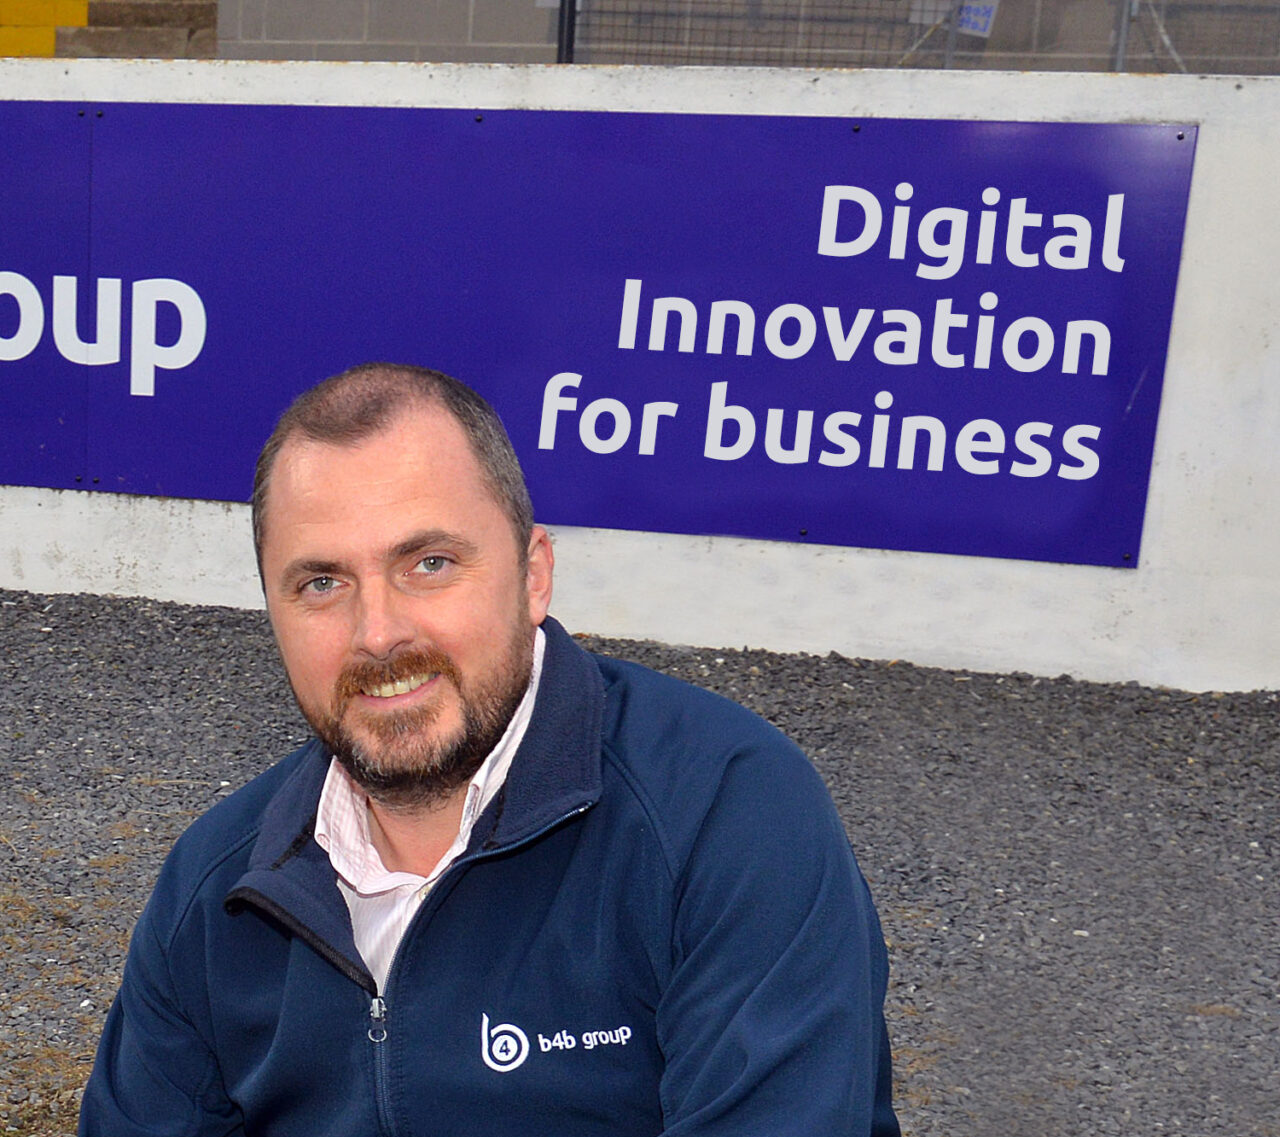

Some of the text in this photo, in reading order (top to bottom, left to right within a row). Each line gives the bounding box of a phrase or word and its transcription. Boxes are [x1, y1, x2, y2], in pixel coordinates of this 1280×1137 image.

[818, 183, 1124, 279] Digital
[619, 279, 1110, 375] Innovation
[539, 373, 1101, 480] for business
[537, 1026, 632, 1052] b4b group
